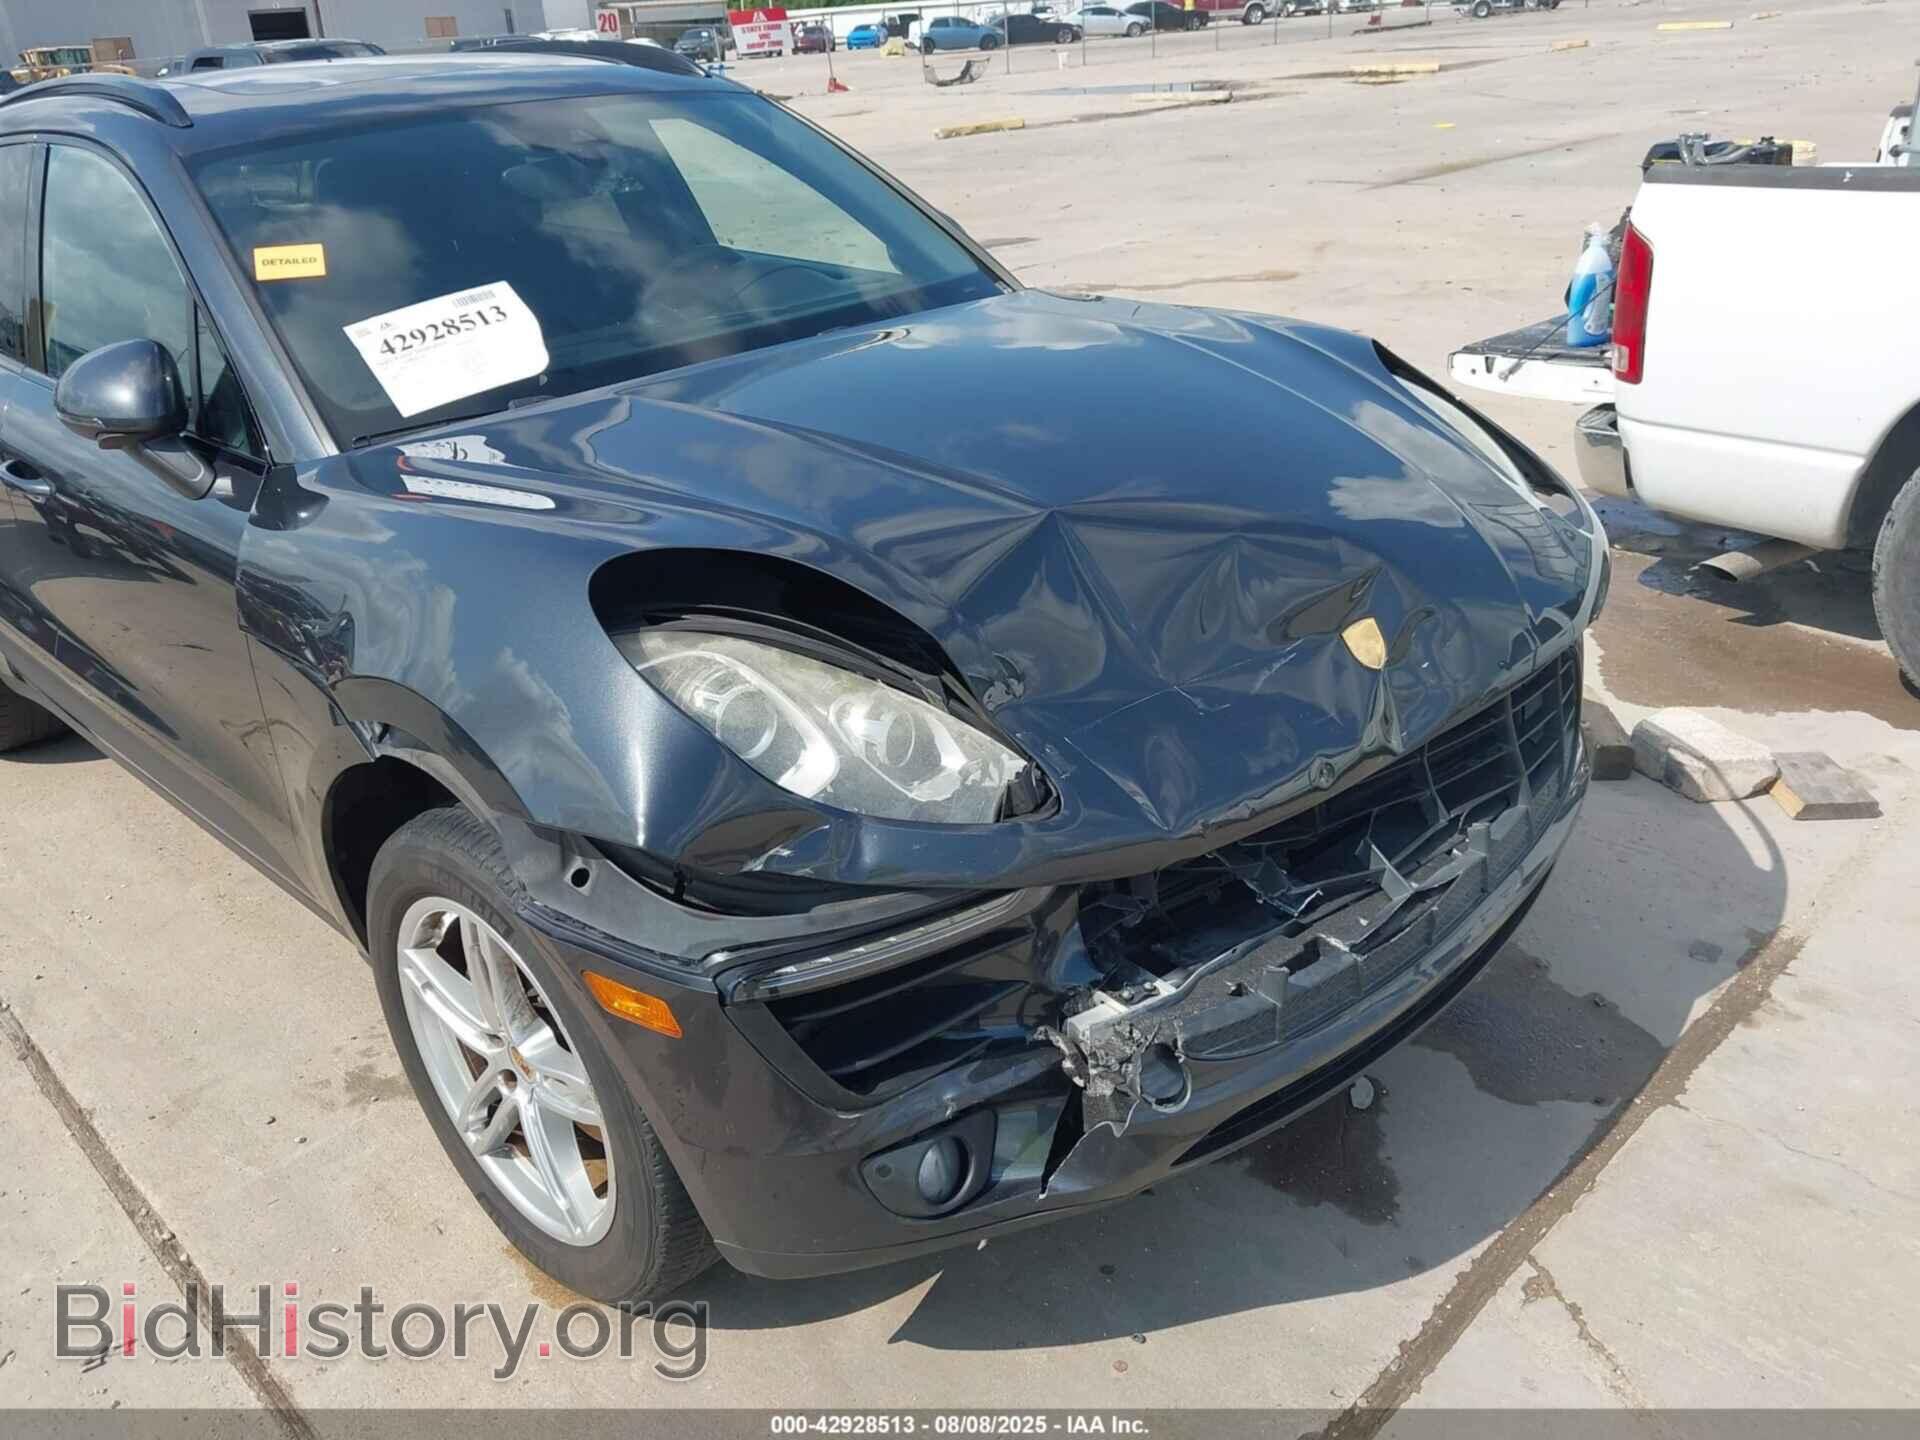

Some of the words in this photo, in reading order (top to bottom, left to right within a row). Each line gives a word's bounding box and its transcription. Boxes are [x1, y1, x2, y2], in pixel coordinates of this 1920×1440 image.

[598, 13, 617, 33] 20
[262, 256, 318, 267] DETAILED
[379, 305, 508, 355] 42928513
